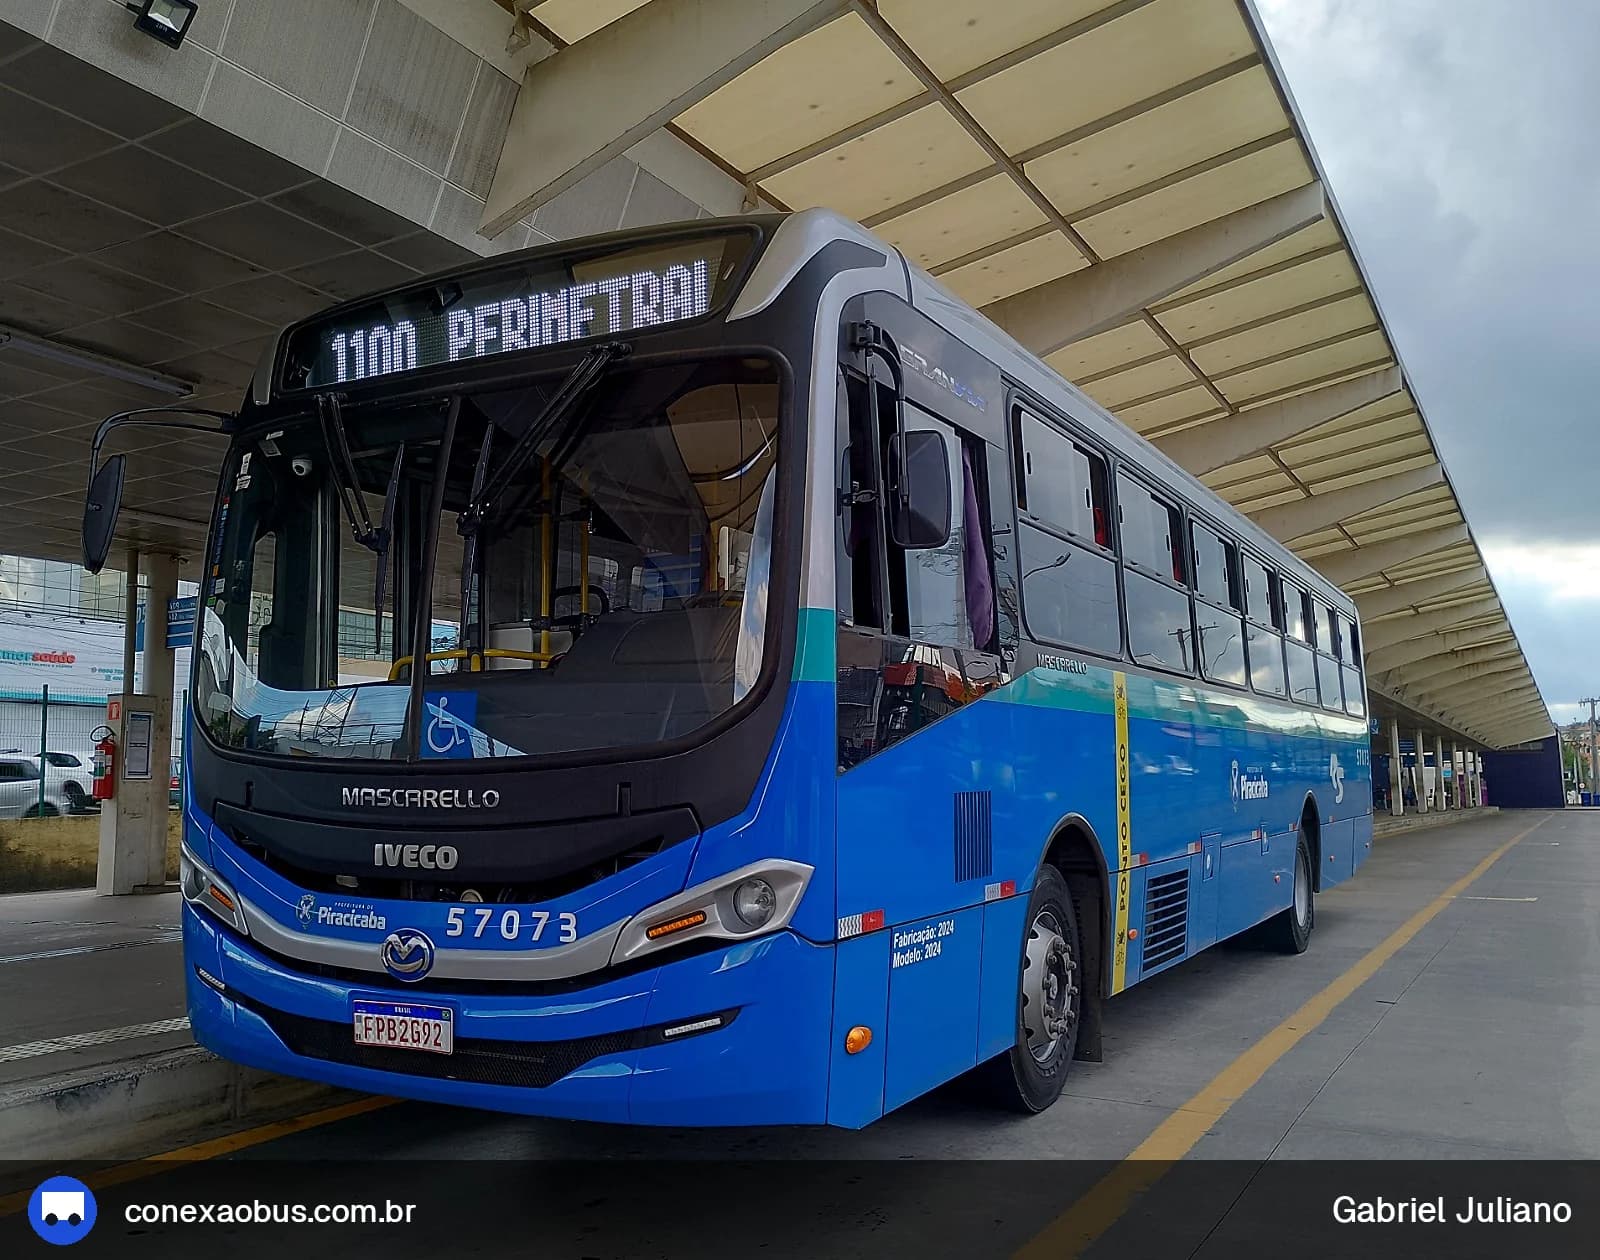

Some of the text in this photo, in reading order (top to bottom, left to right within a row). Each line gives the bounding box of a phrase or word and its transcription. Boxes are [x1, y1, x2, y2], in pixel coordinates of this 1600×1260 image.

[1036, 653, 1088, 675] MASCARELLO
[342, 787, 500, 808] MASCARELLO
[1240, 774, 1268, 800] Piracicaba
[1118, 743, 1129, 911] PONTO CEGO
[374, 843, 459, 870] IVECO
[318, 906, 386, 930] Piracicaba
[446, 907, 577, 943] 57073
[893, 919, 954, 949] Fabricação: 2024
[892, 940, 941, 969] Modelo: 2024
[364, 1016, 442, 1047] FPB2G92
